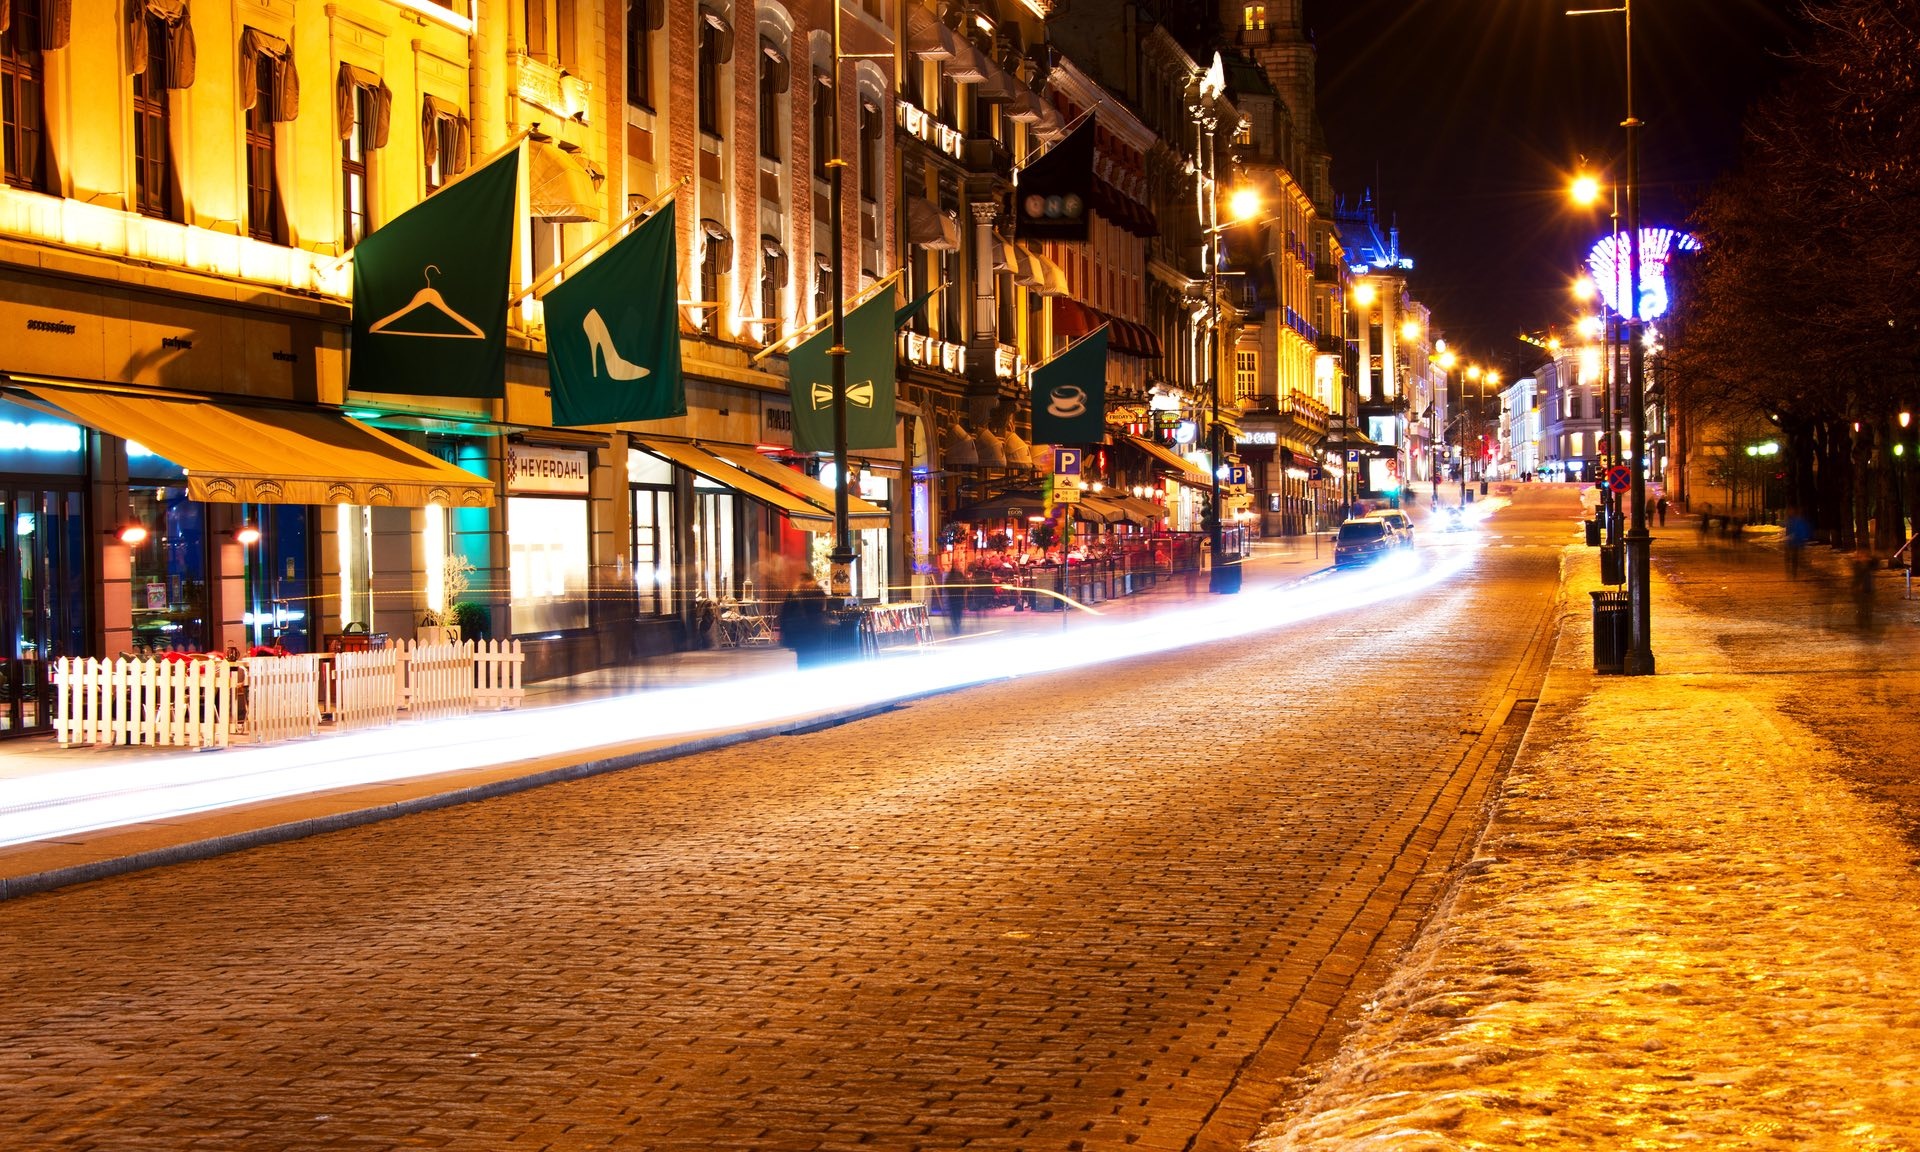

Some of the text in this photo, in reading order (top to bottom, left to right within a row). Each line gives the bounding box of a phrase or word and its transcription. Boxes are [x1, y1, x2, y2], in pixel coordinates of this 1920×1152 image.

[1061, 452, 1076, 473] P
[1349, 451, 1356, 461] P
[521, 458, 584, 480] HEYERDAHL
[1233, 469, 1243, 483] P
[1310, 468, 1319, 479] P
